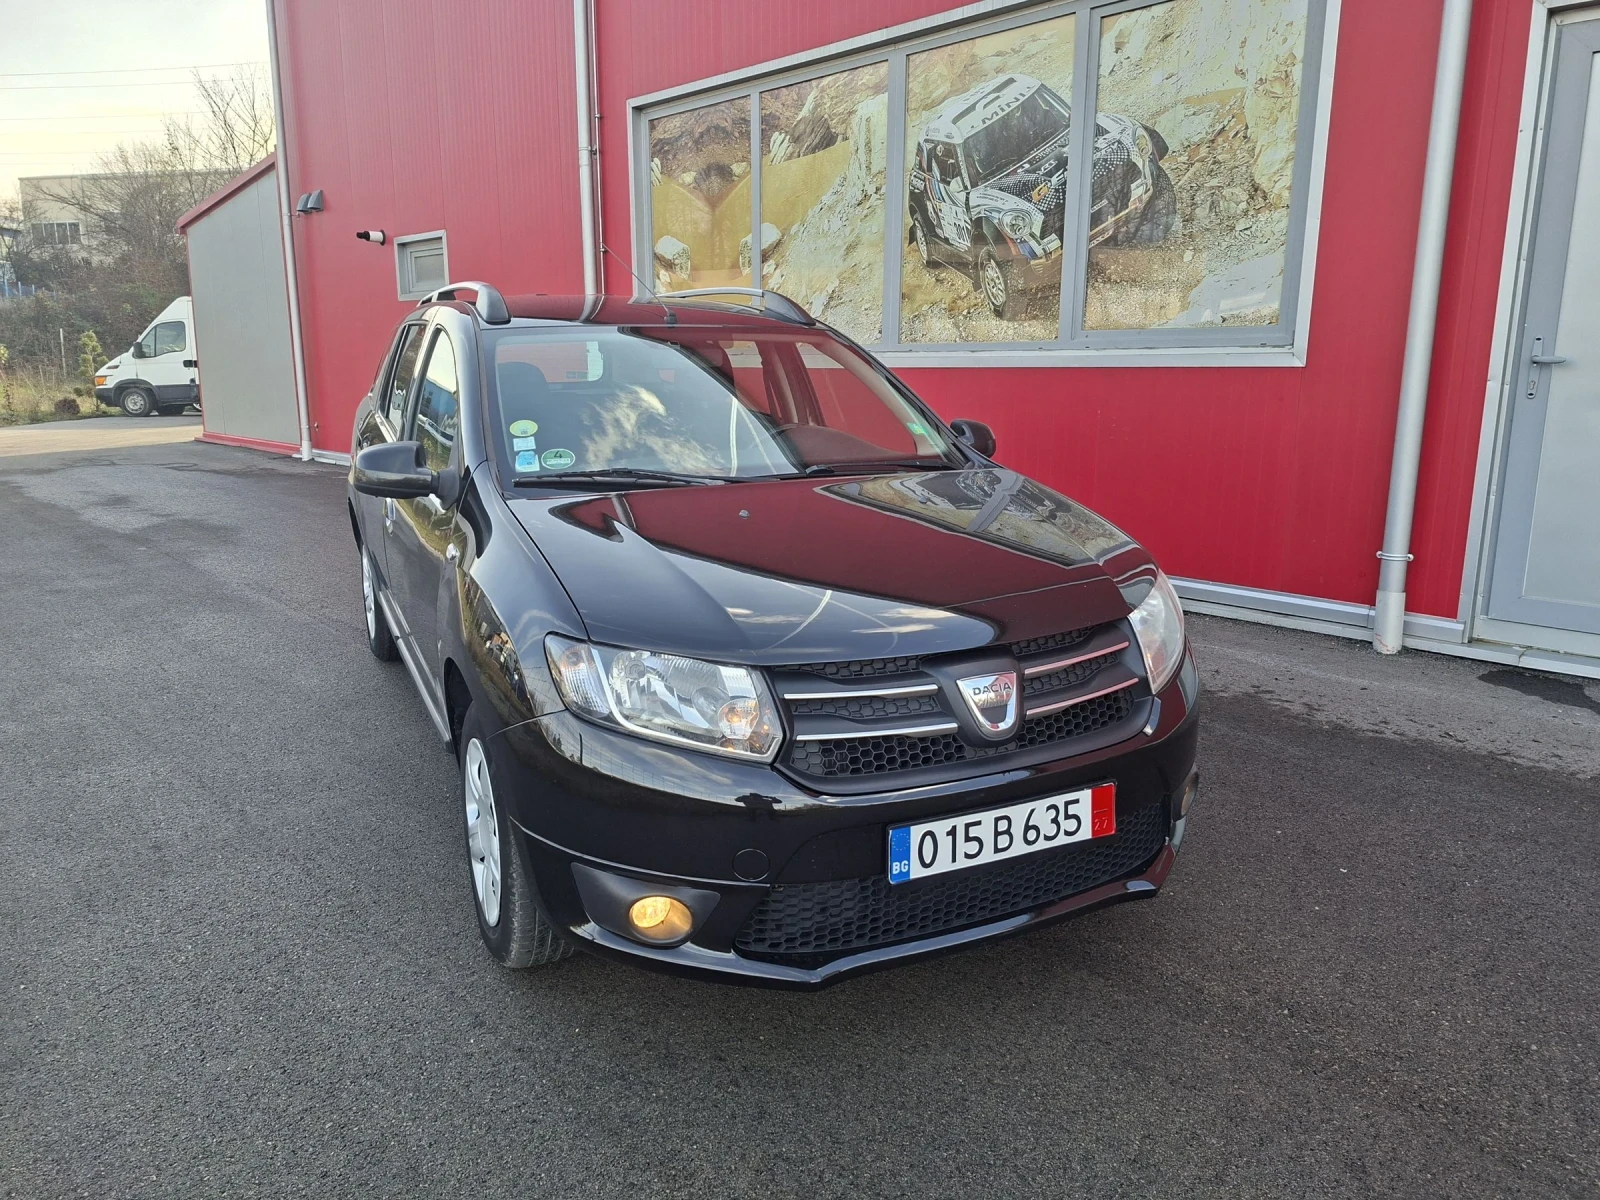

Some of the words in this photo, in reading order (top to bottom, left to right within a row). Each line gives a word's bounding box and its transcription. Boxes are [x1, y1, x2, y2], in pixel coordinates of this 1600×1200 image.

[554, 450, 562, 458] 4
[972, 682, 1012, 696] DACIA
[892, 859, 909, 874] BG
